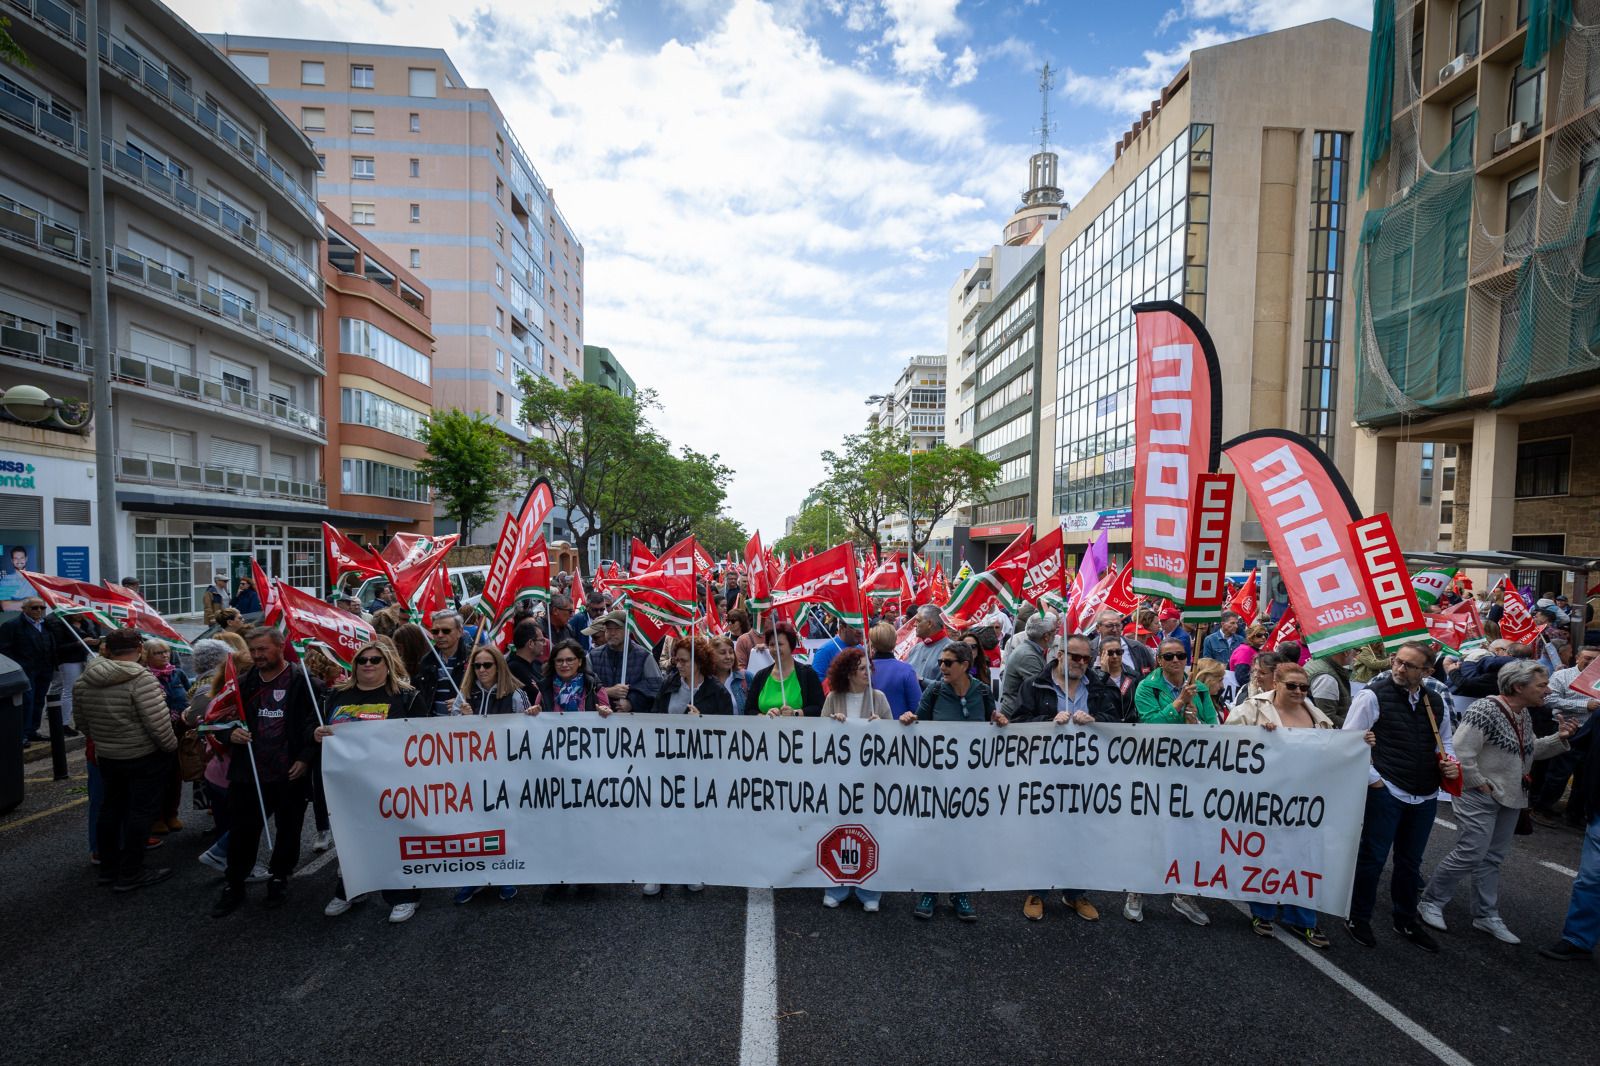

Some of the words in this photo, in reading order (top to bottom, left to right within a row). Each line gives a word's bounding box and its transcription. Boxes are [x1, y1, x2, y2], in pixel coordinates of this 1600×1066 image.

[1193, 481, 1227, 599] CCOO
[1356, 521, 1415, 628] CCOO
[404, 731, 498, 768] CONTRA
[507, 728, 532, 762] LA
[541, 726, 647, 762] APERTURA
[654, 727, 769, 763] ILIMITADA
[778, 730, 804, 765] DE
[812, 732, 852, 766] LAS
[859, 732, 959, 770] GRANDES
[967, 732, 1100, 770] SUPERFICIES
[1107, 735, 1266, 775] COMERCIALES
[379, 781, 474, 820] CONTRA
[482, 778, 510, 813] LA
[518, 764, 652, 811] AMPLIACIÓN
[660, 774, 686, 809] DE
[693, 775, 718, 810] LA
[726, 776, 829, 815] APERTURA
[838, 782, 865, 816] DE
[873, 781, 990, 820] DOMINGOS
[998, 783, 1011, 817] Y
[1017, 781, 1122, 817] FESTIVOS
[1130, 780, 1161, 817] EN
[1168, 782, 1195, 819] EL
[1203, 787, 1326, 829] COMERCIO
[405, 837, 481, 855] CCOO
[841, 849, 859, 865] NO
[1220, 827, 1266, 858] NO
[402, 859, 487, 875] servicios
[491, 858, 526, 871] cádiz
[1164, 859, 1182, 885] A
[1193, 860, 1229, 890] LA
[1240, 865, 1323, 899] ZGAT
